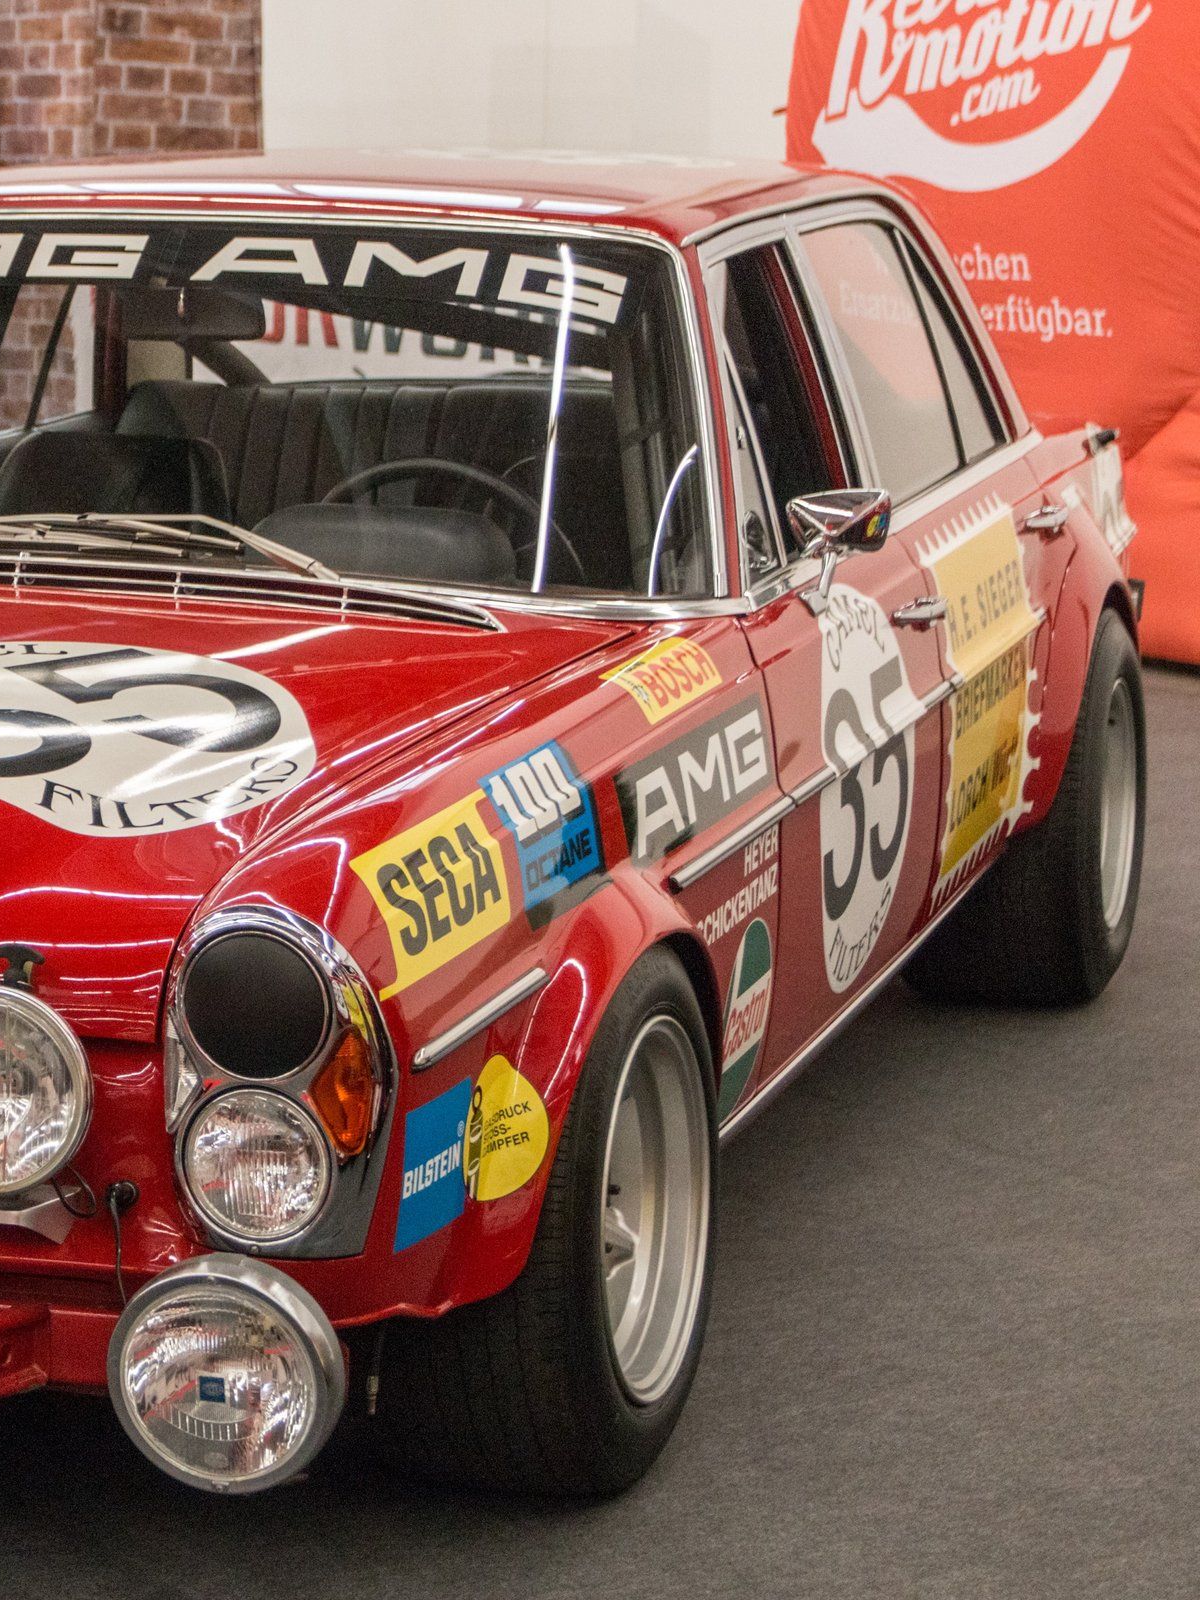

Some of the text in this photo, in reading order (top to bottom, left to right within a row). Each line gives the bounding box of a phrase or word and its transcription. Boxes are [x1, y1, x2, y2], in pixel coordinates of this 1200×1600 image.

[950, 67, 1041, 127] .com
[191, 234, 628, 326] AMG
[953, 243, 1032, 282] chen
[979, 295, 1113, 342] erfügbar.
[632, 642, 717, 709] BOSCH
[34, 756, 299, 830] FILTERS
[488, 748, 582, 842] 100
[635, 709, 769, 860] AMG
[823, 655, 909, 920] 35
[525, 828, 593, 893] OCTANE
[743, 823, 779, 878] HEYER
[376, 822, 502, 957] SECA
[402, 1140, 462, 1200] BILSTEIN
[483, 1131, 530, 1158] MPFER
